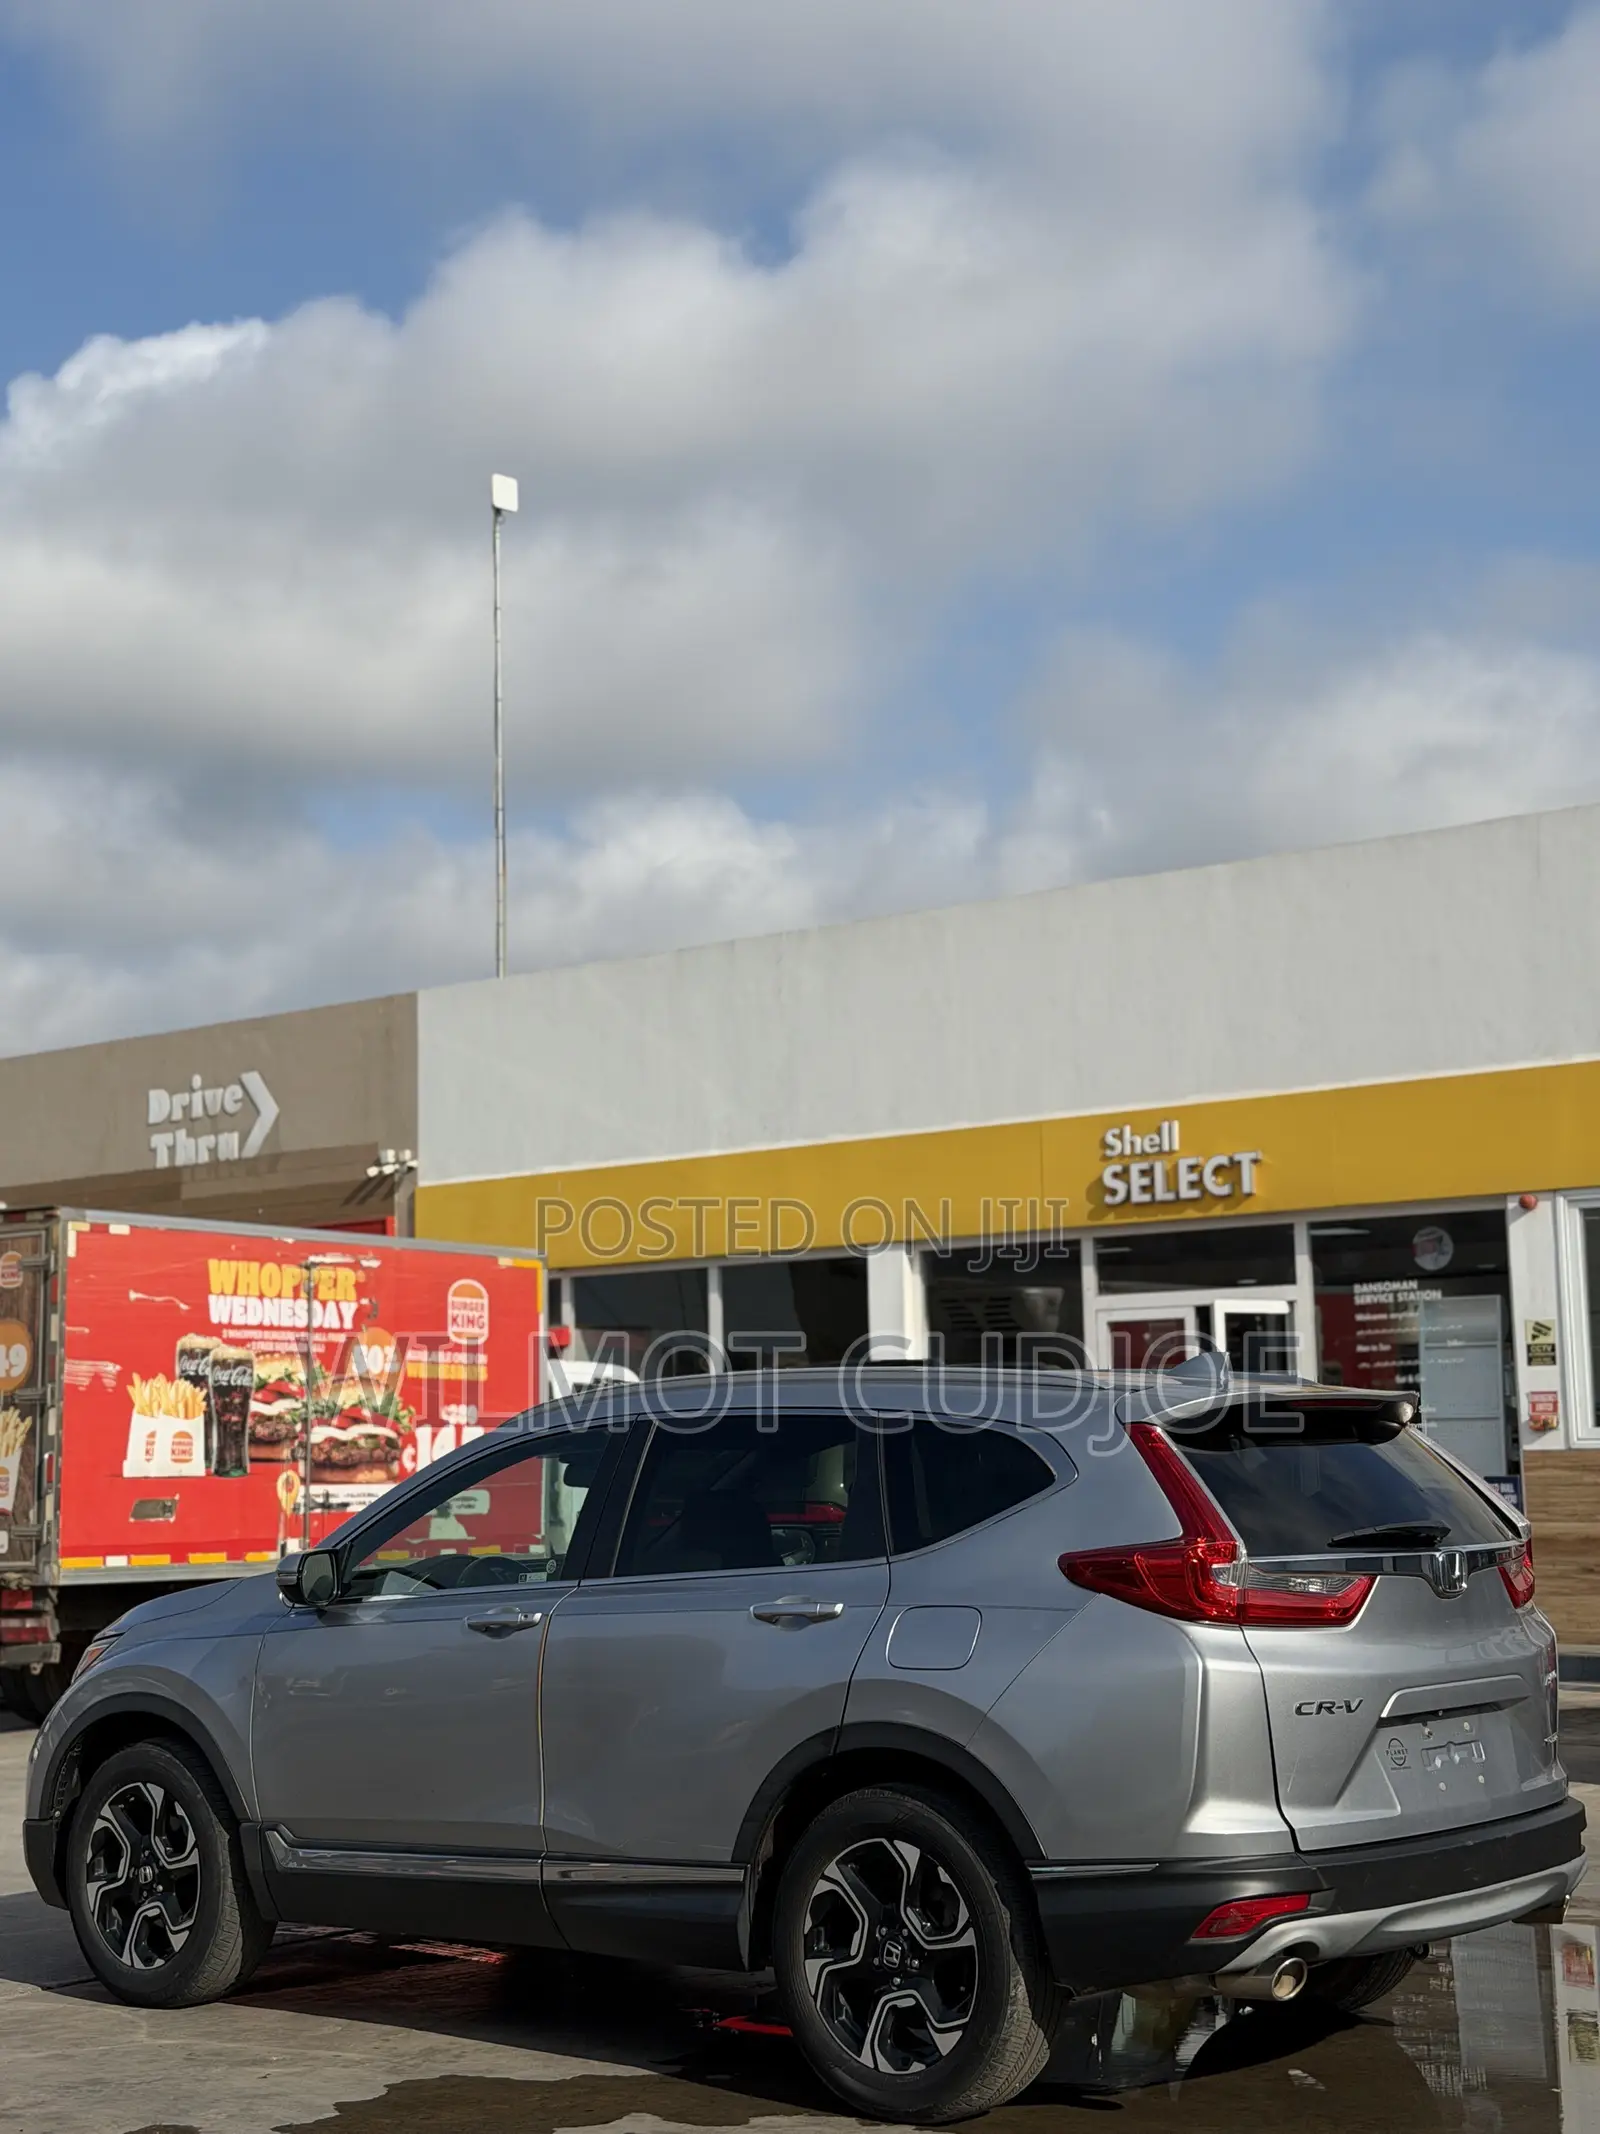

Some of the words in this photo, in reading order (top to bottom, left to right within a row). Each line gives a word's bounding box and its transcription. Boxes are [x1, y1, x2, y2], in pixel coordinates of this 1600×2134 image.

[148, 1074, 243, 1124] Drive
[150, 1128, 240, 1168] Thru
[1104, 1120, 1180, 1157] Shell
[1102, 1150, 1262, 1206] SELECT
[207, 1258, 358, 1301] WHOPPER
[451, 1300, 485, 1313] BURGER
[1354, 1293, 1395, 1306] SERVICE
[1397, 1289, 1442, 1303] STATION
[207, 1294, 358, 1330] WEDNESDAY
[451, 1314, 486, 1330] KING
[171, 1449, 193, 1458] KING
[1294, 1697, 1364, 1716] CR-V
[1385, 1748, 1408, 1756] PLANET
